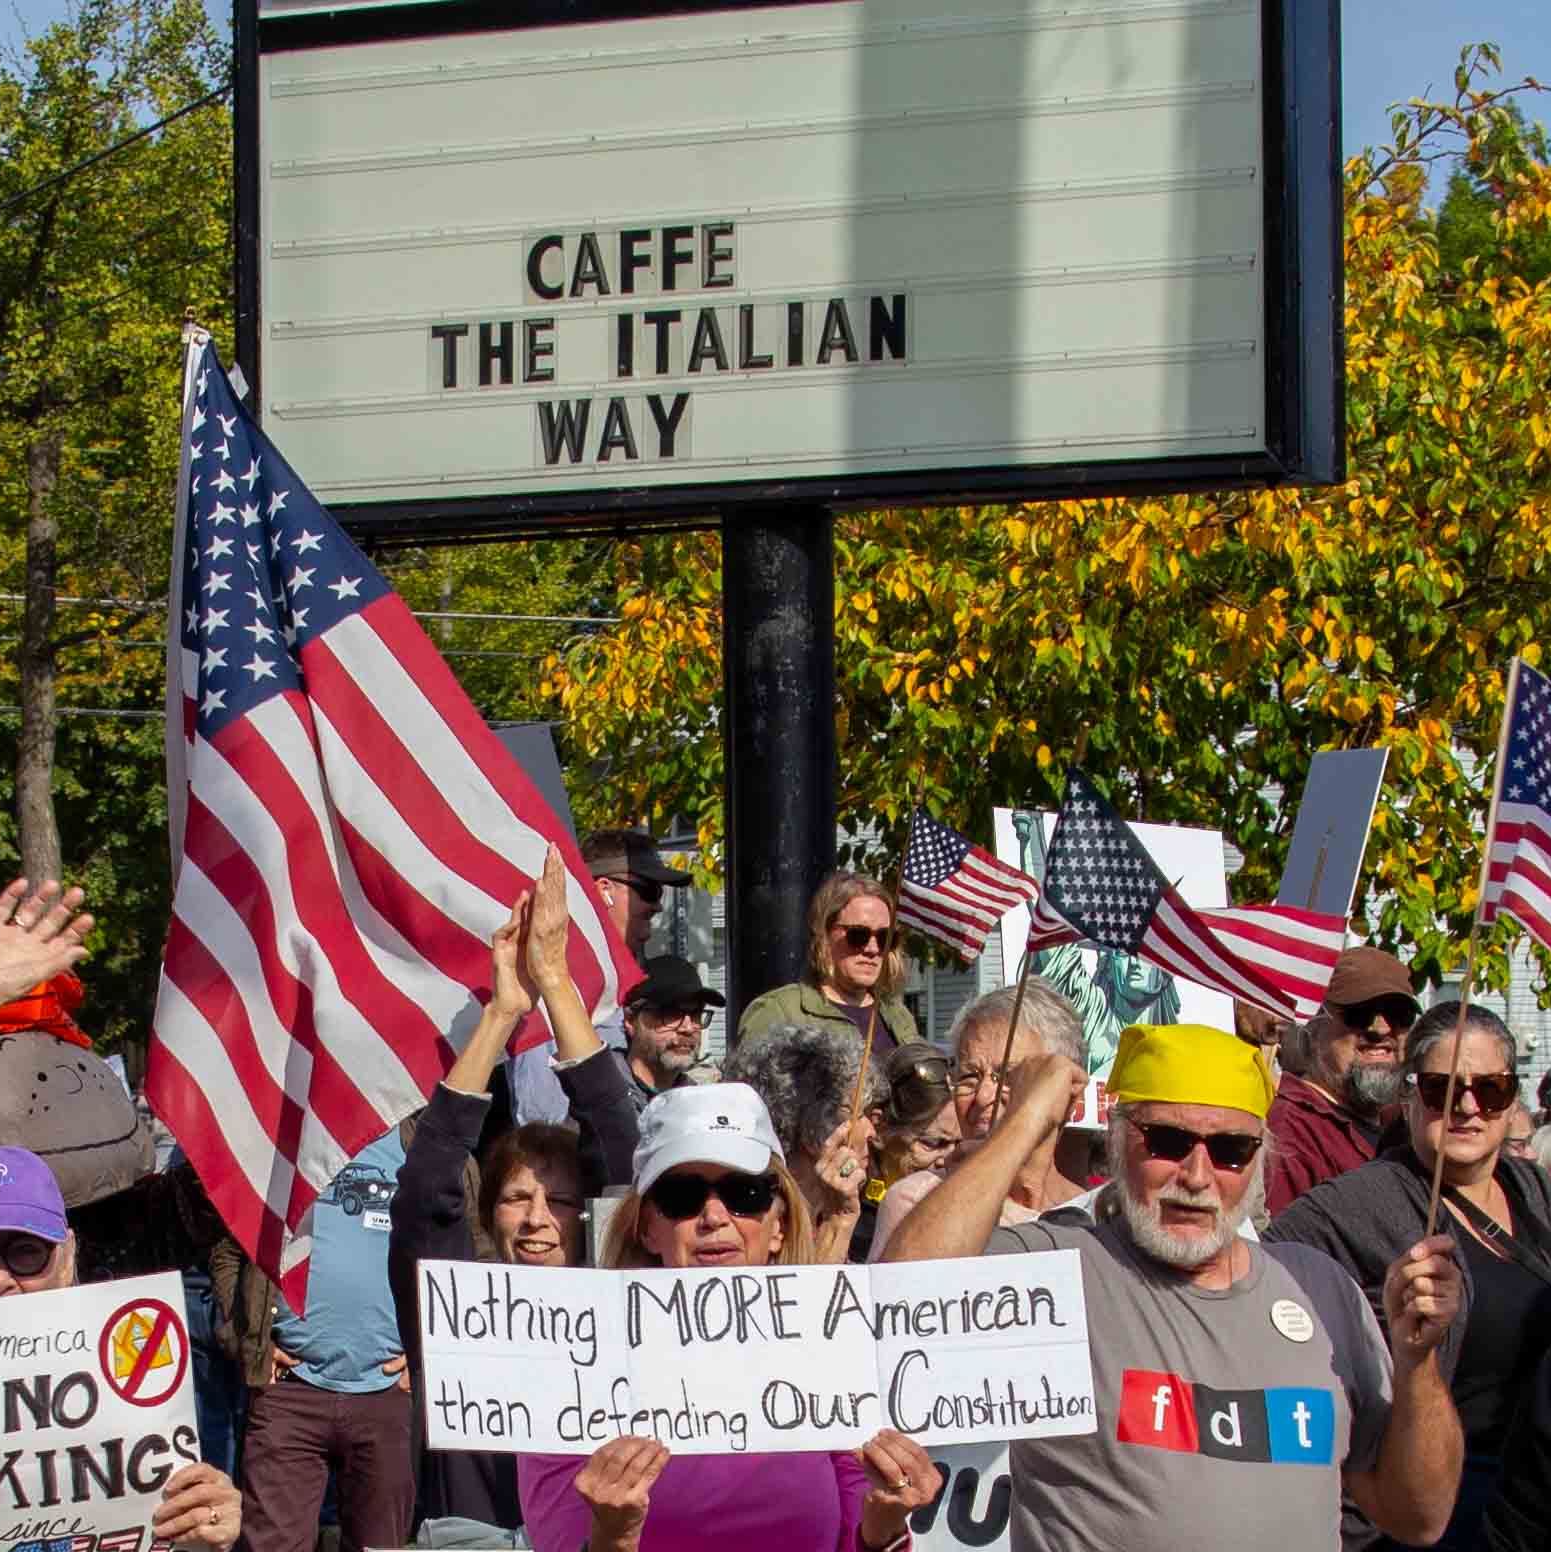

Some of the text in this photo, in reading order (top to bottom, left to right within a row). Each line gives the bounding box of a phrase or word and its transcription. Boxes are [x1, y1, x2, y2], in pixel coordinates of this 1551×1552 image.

[526, 223, 736, 300] CAFFE
[432, 294, 907, 389] THE ITALIAN
[537, 392, 690, 464] WAY
[426, 1268, 1066, 1366] Nothing MORE American
[3, 1371, 99, 1433] NO
[434, 1349, 1093, 1450] than defending Our Constitution
